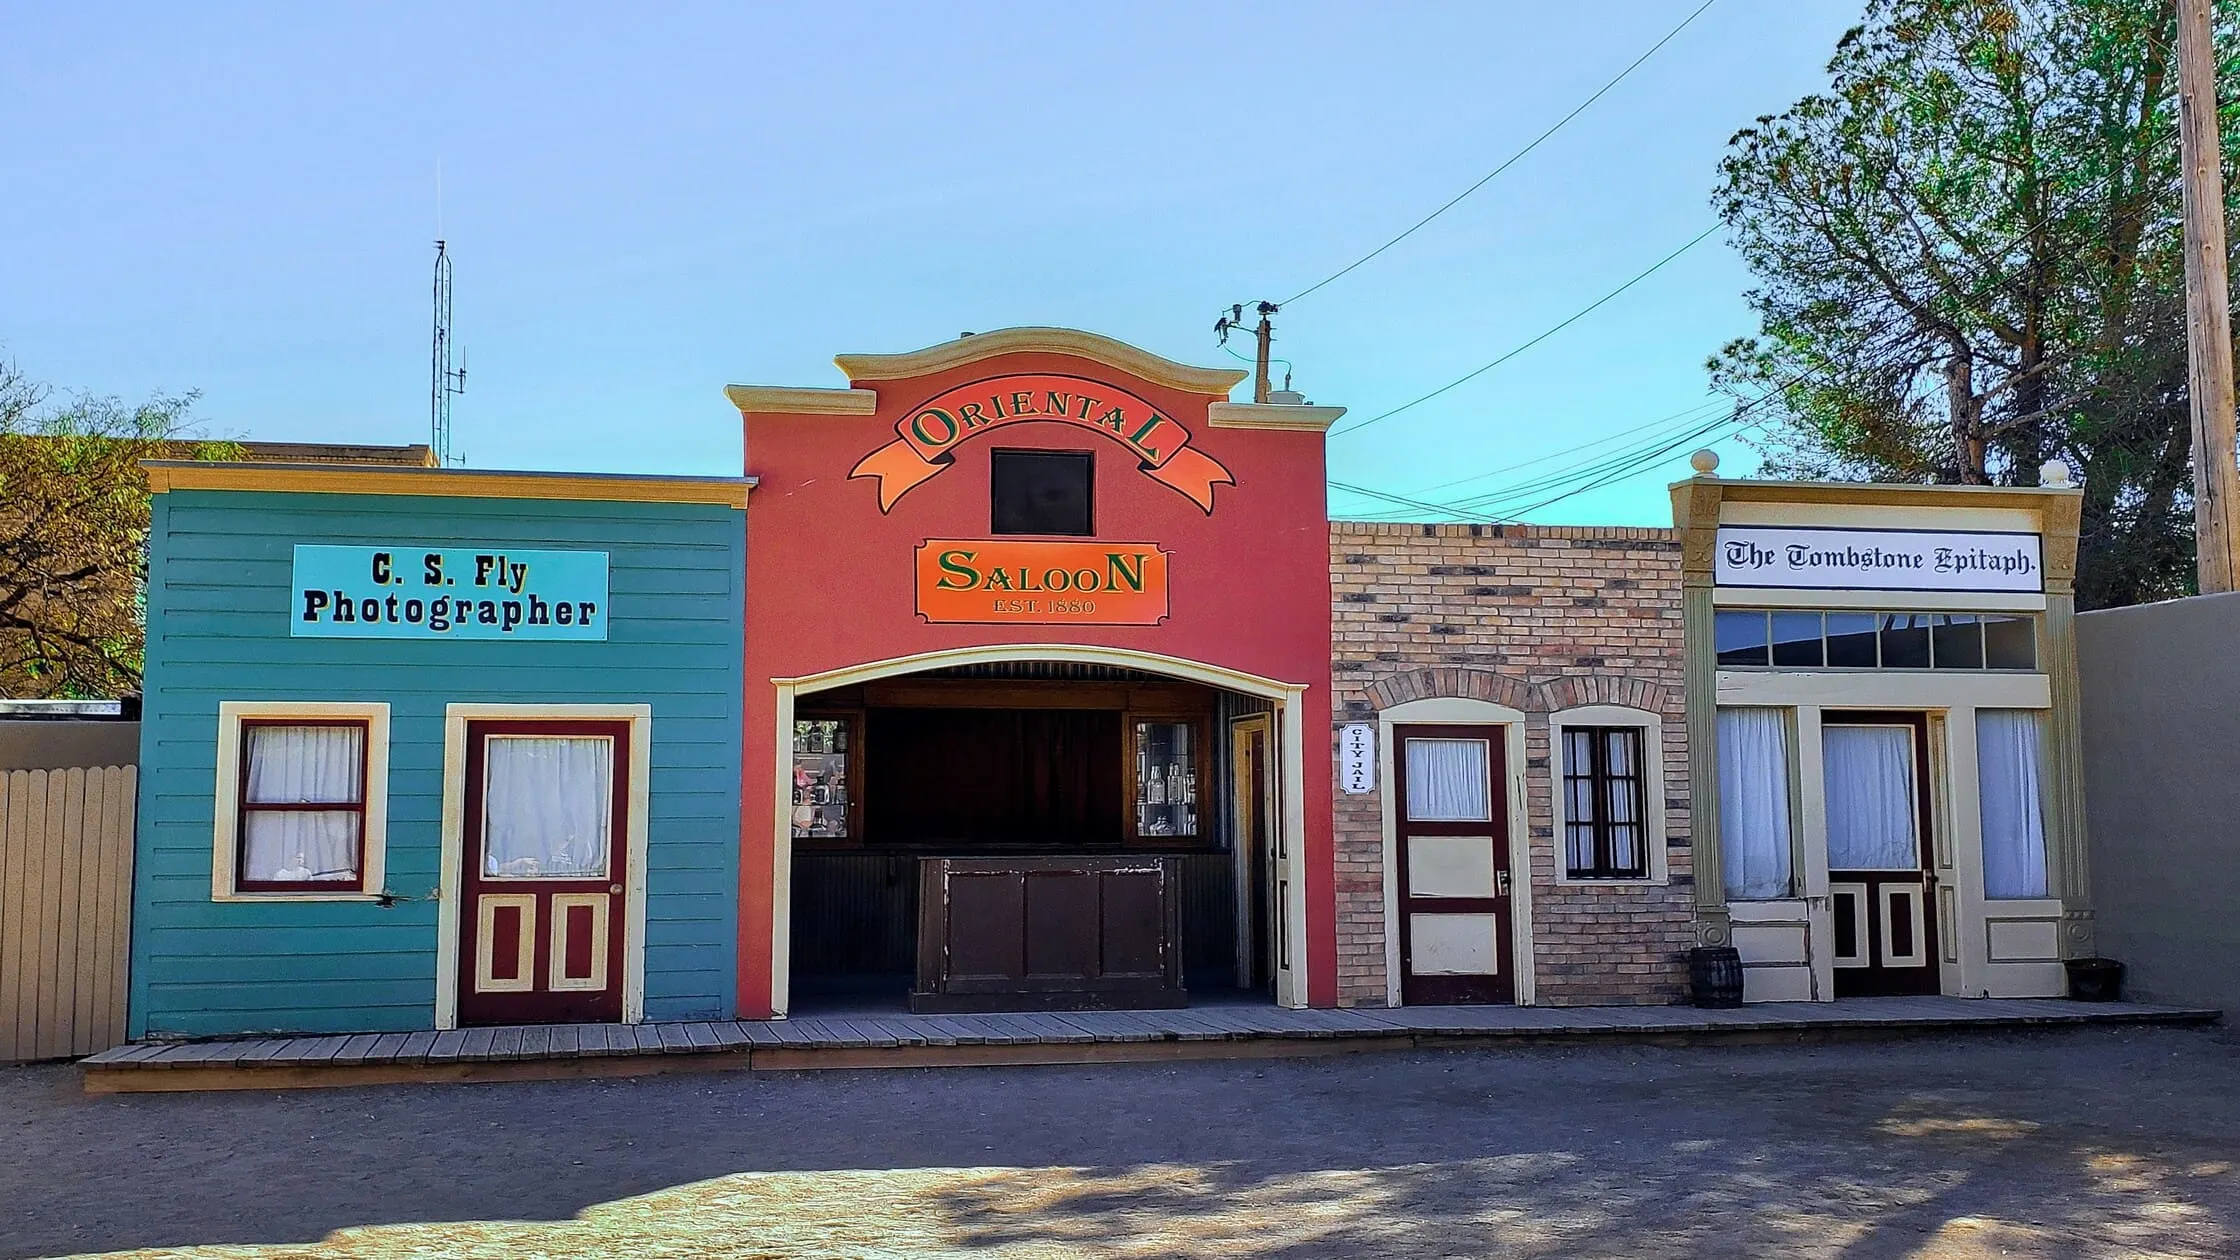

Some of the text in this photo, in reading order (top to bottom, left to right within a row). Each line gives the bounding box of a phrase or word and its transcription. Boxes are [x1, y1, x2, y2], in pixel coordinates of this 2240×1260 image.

[911, 392, 1165, 462] ORIENTAL
[371, 552, 528, 594] C. S. Fly
[936, 550, 1148, 593] SALOON
[1724, 540, 2036, 575] The Tombstone Epitaph.
[302, 589, 597, 632] Photographer
[993, 598, 1096, 615] EST. 1880
[1350, 729, 1365, 789] CITY JAIL
